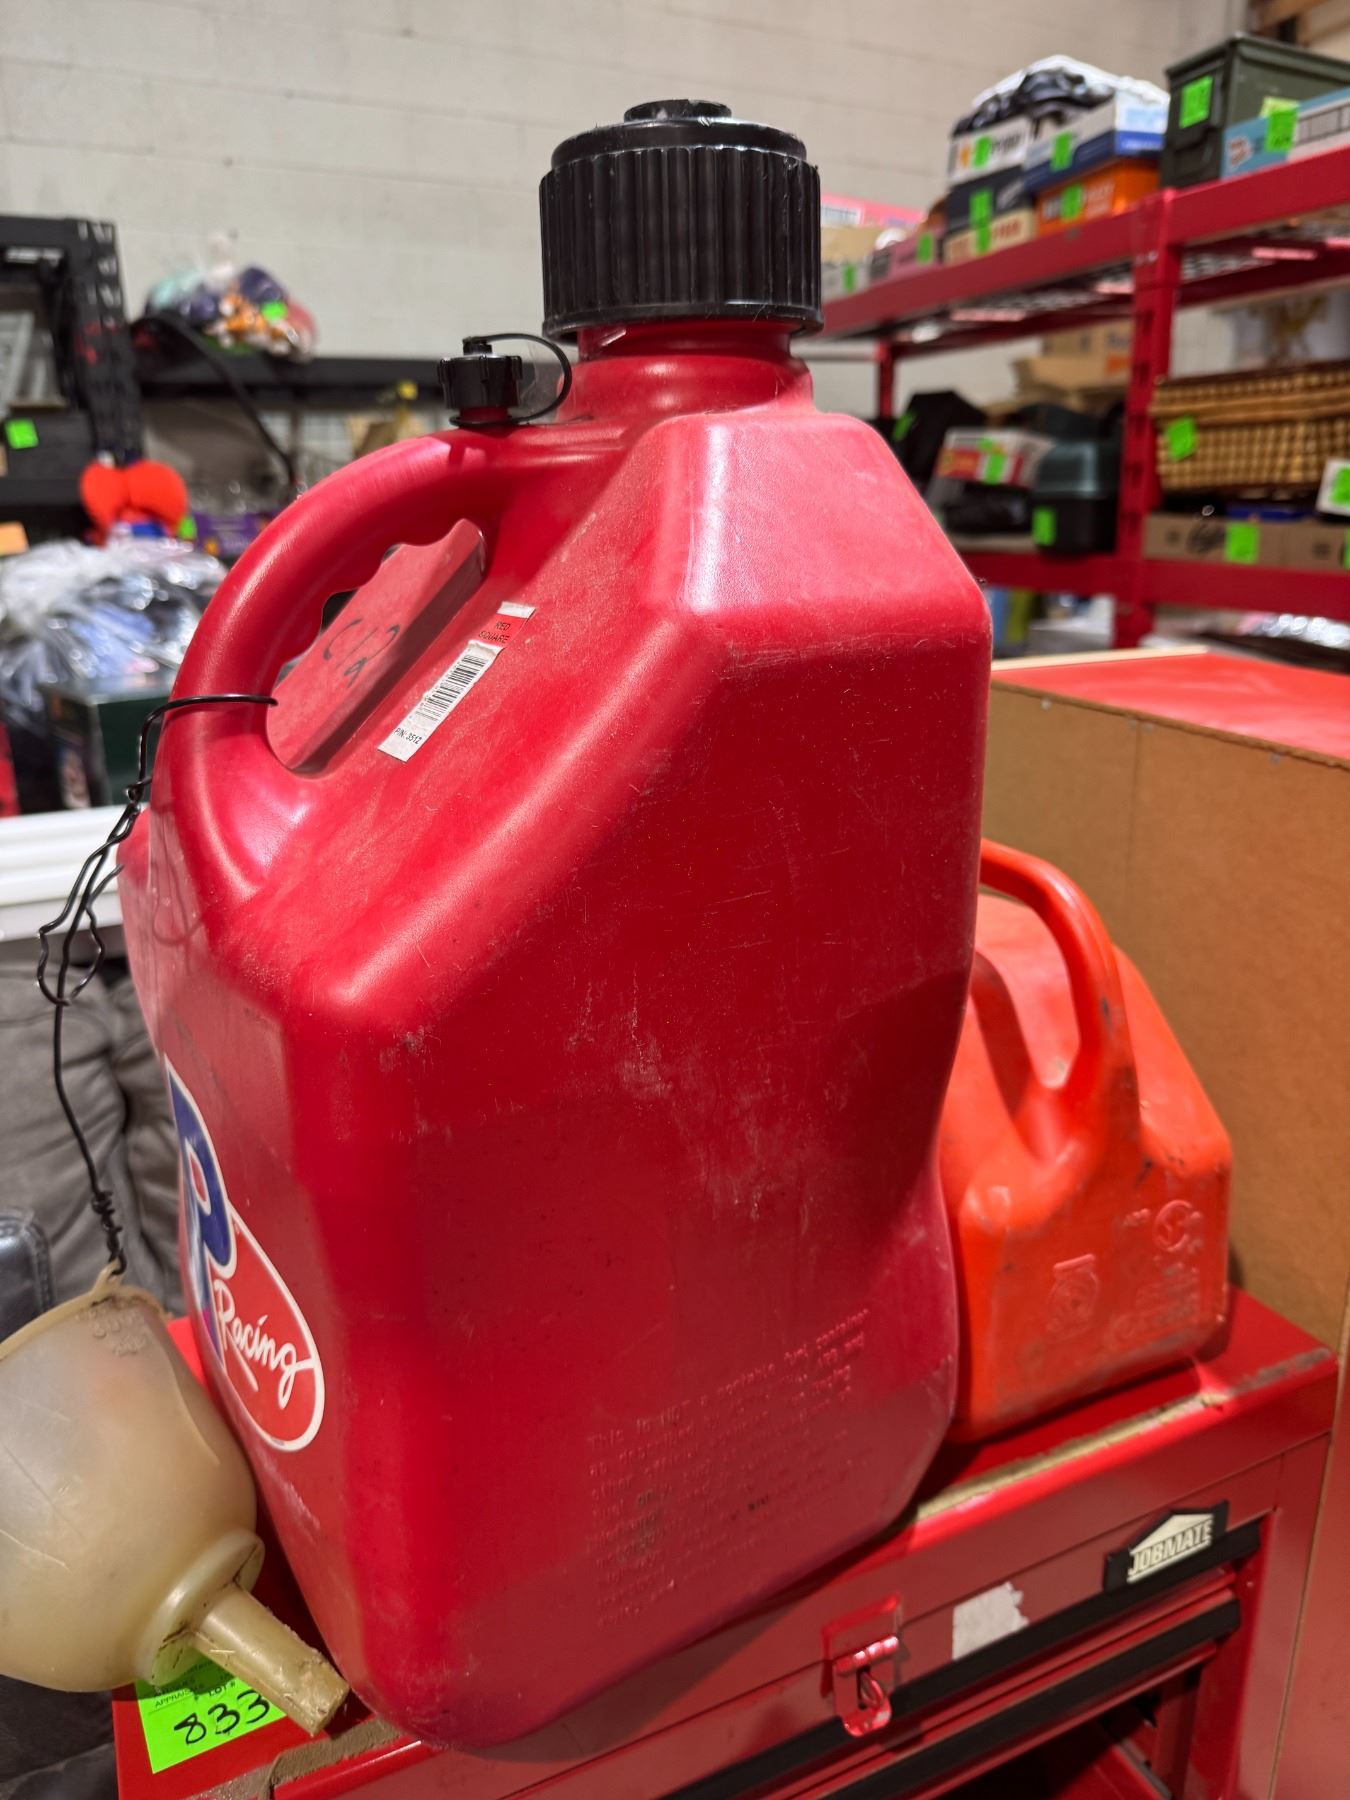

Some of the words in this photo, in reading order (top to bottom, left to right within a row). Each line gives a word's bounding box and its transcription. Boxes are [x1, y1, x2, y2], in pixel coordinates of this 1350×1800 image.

[478, 630, 510, 644] SQUARE
[495, 620, 511, 631] RED
[406, 732, 423, 745] 3512
[213, 1279, 309, 1409] Racing
[1127, 1519, 1214, 1577] JOBMATE
[173, 1689, 270, 1745] 833
